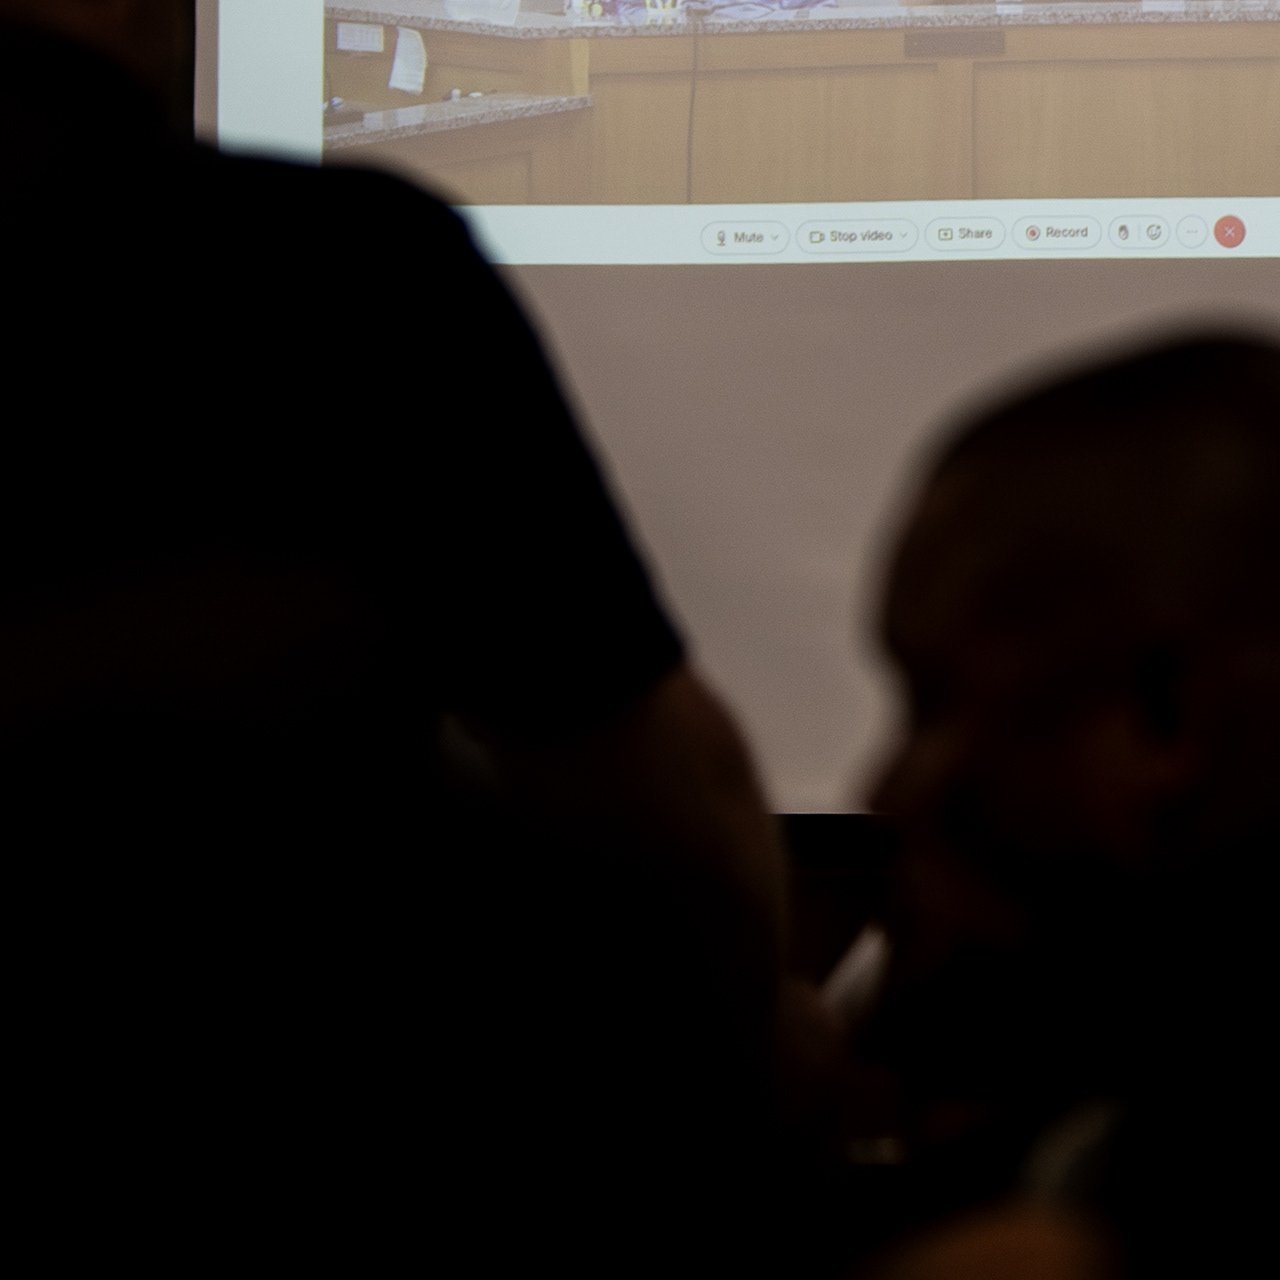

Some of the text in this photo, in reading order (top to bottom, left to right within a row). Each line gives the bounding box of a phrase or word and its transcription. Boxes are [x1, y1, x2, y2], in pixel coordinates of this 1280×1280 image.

[734, 232, 763, 243] Mute
[830, 230, 892, 243] Stop video
[959, 228, 992, 239] Share
[1046, 227, 1088, 238] Record
